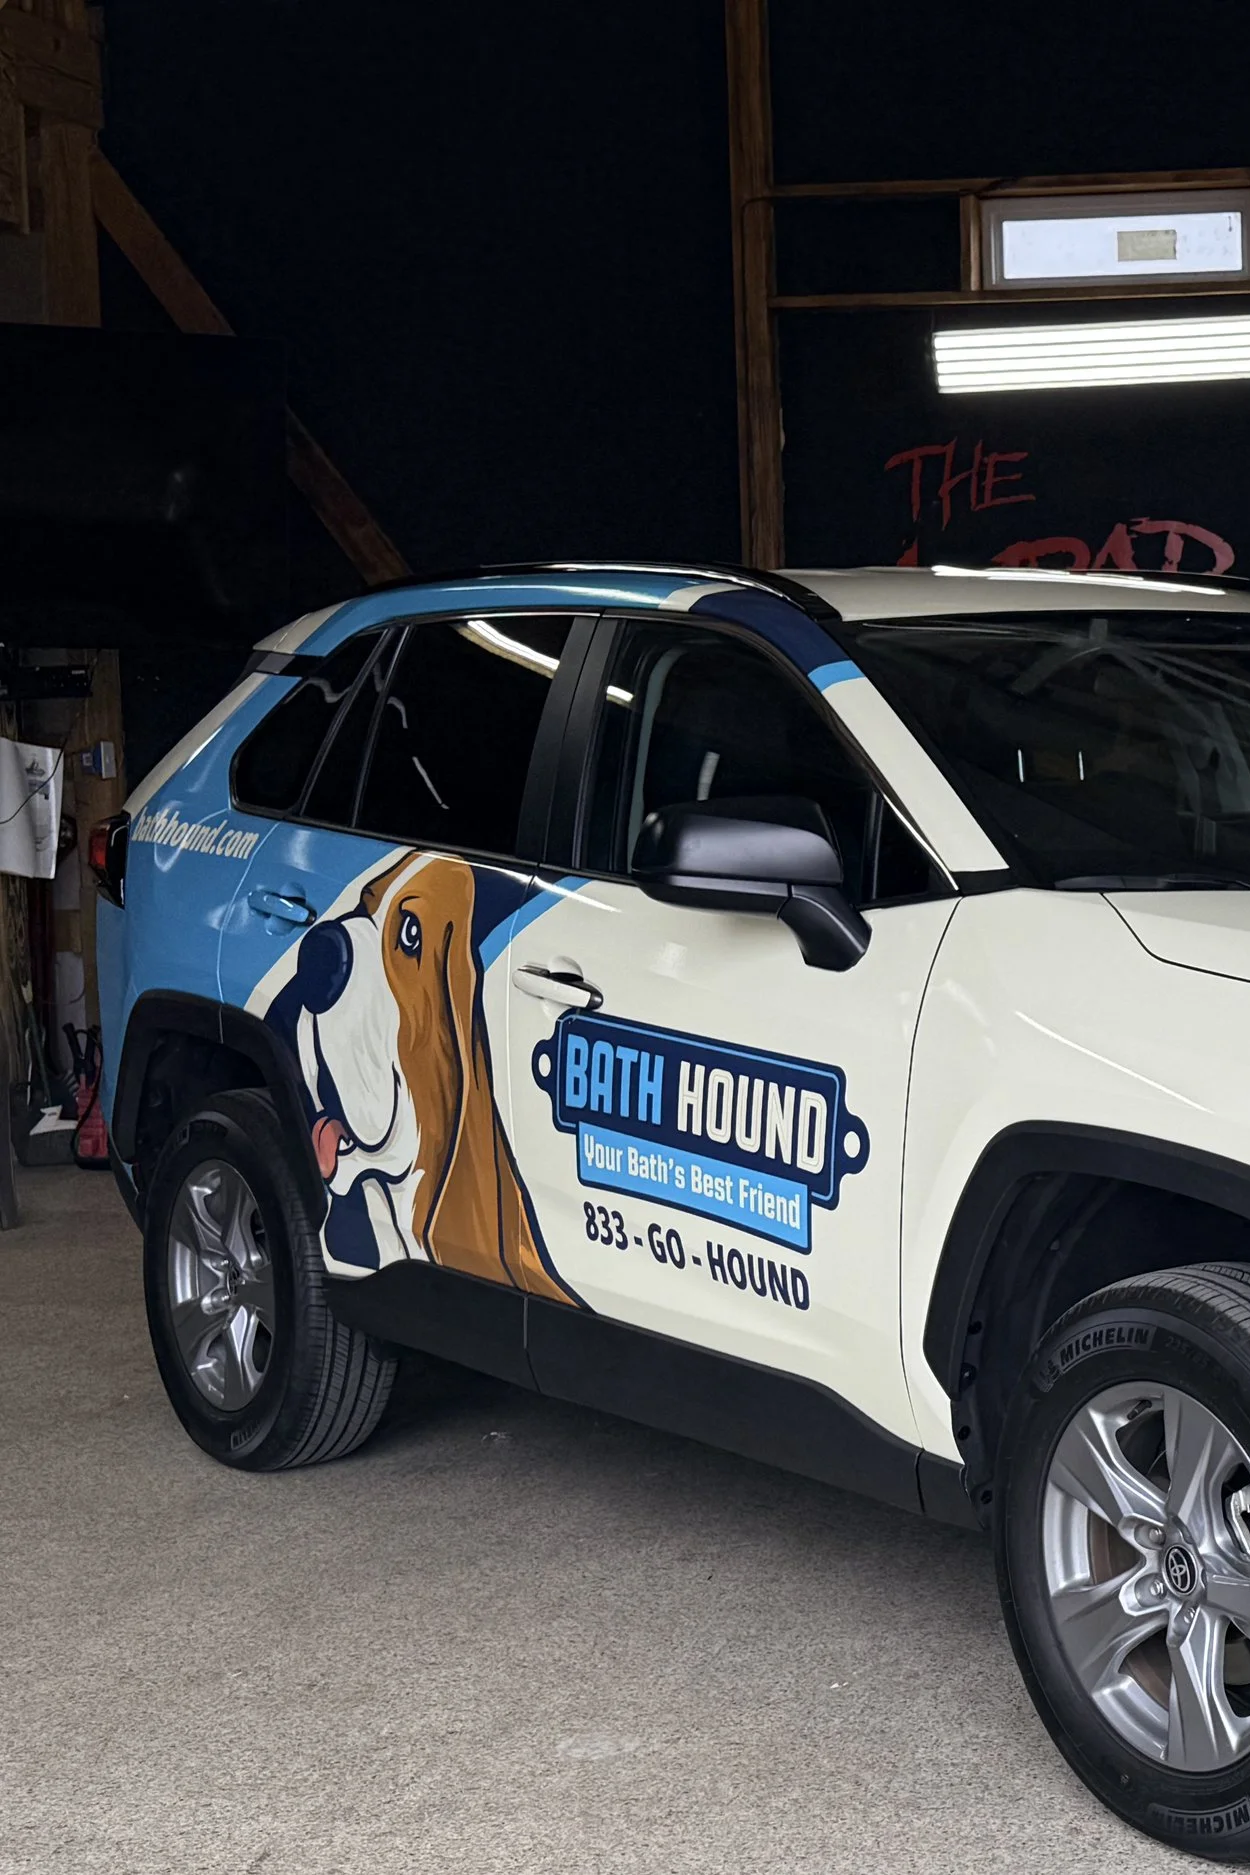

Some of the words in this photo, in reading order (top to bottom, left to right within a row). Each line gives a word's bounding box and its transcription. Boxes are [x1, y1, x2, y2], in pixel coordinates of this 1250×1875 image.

[885, 435, 1036, 531] THE
[565, 1034, 664, 1125] BATH
[677, 1060, 827, 1174] HOUND
[584, 1133, 624, 1173] Your
[628, 1146, 685, 1189] Bath's
[691, 1164, 733, 1205] Best
[739, 1178, 801, 1230] Friend
[1059, 1326, 1150, 1366] MICHELIN
